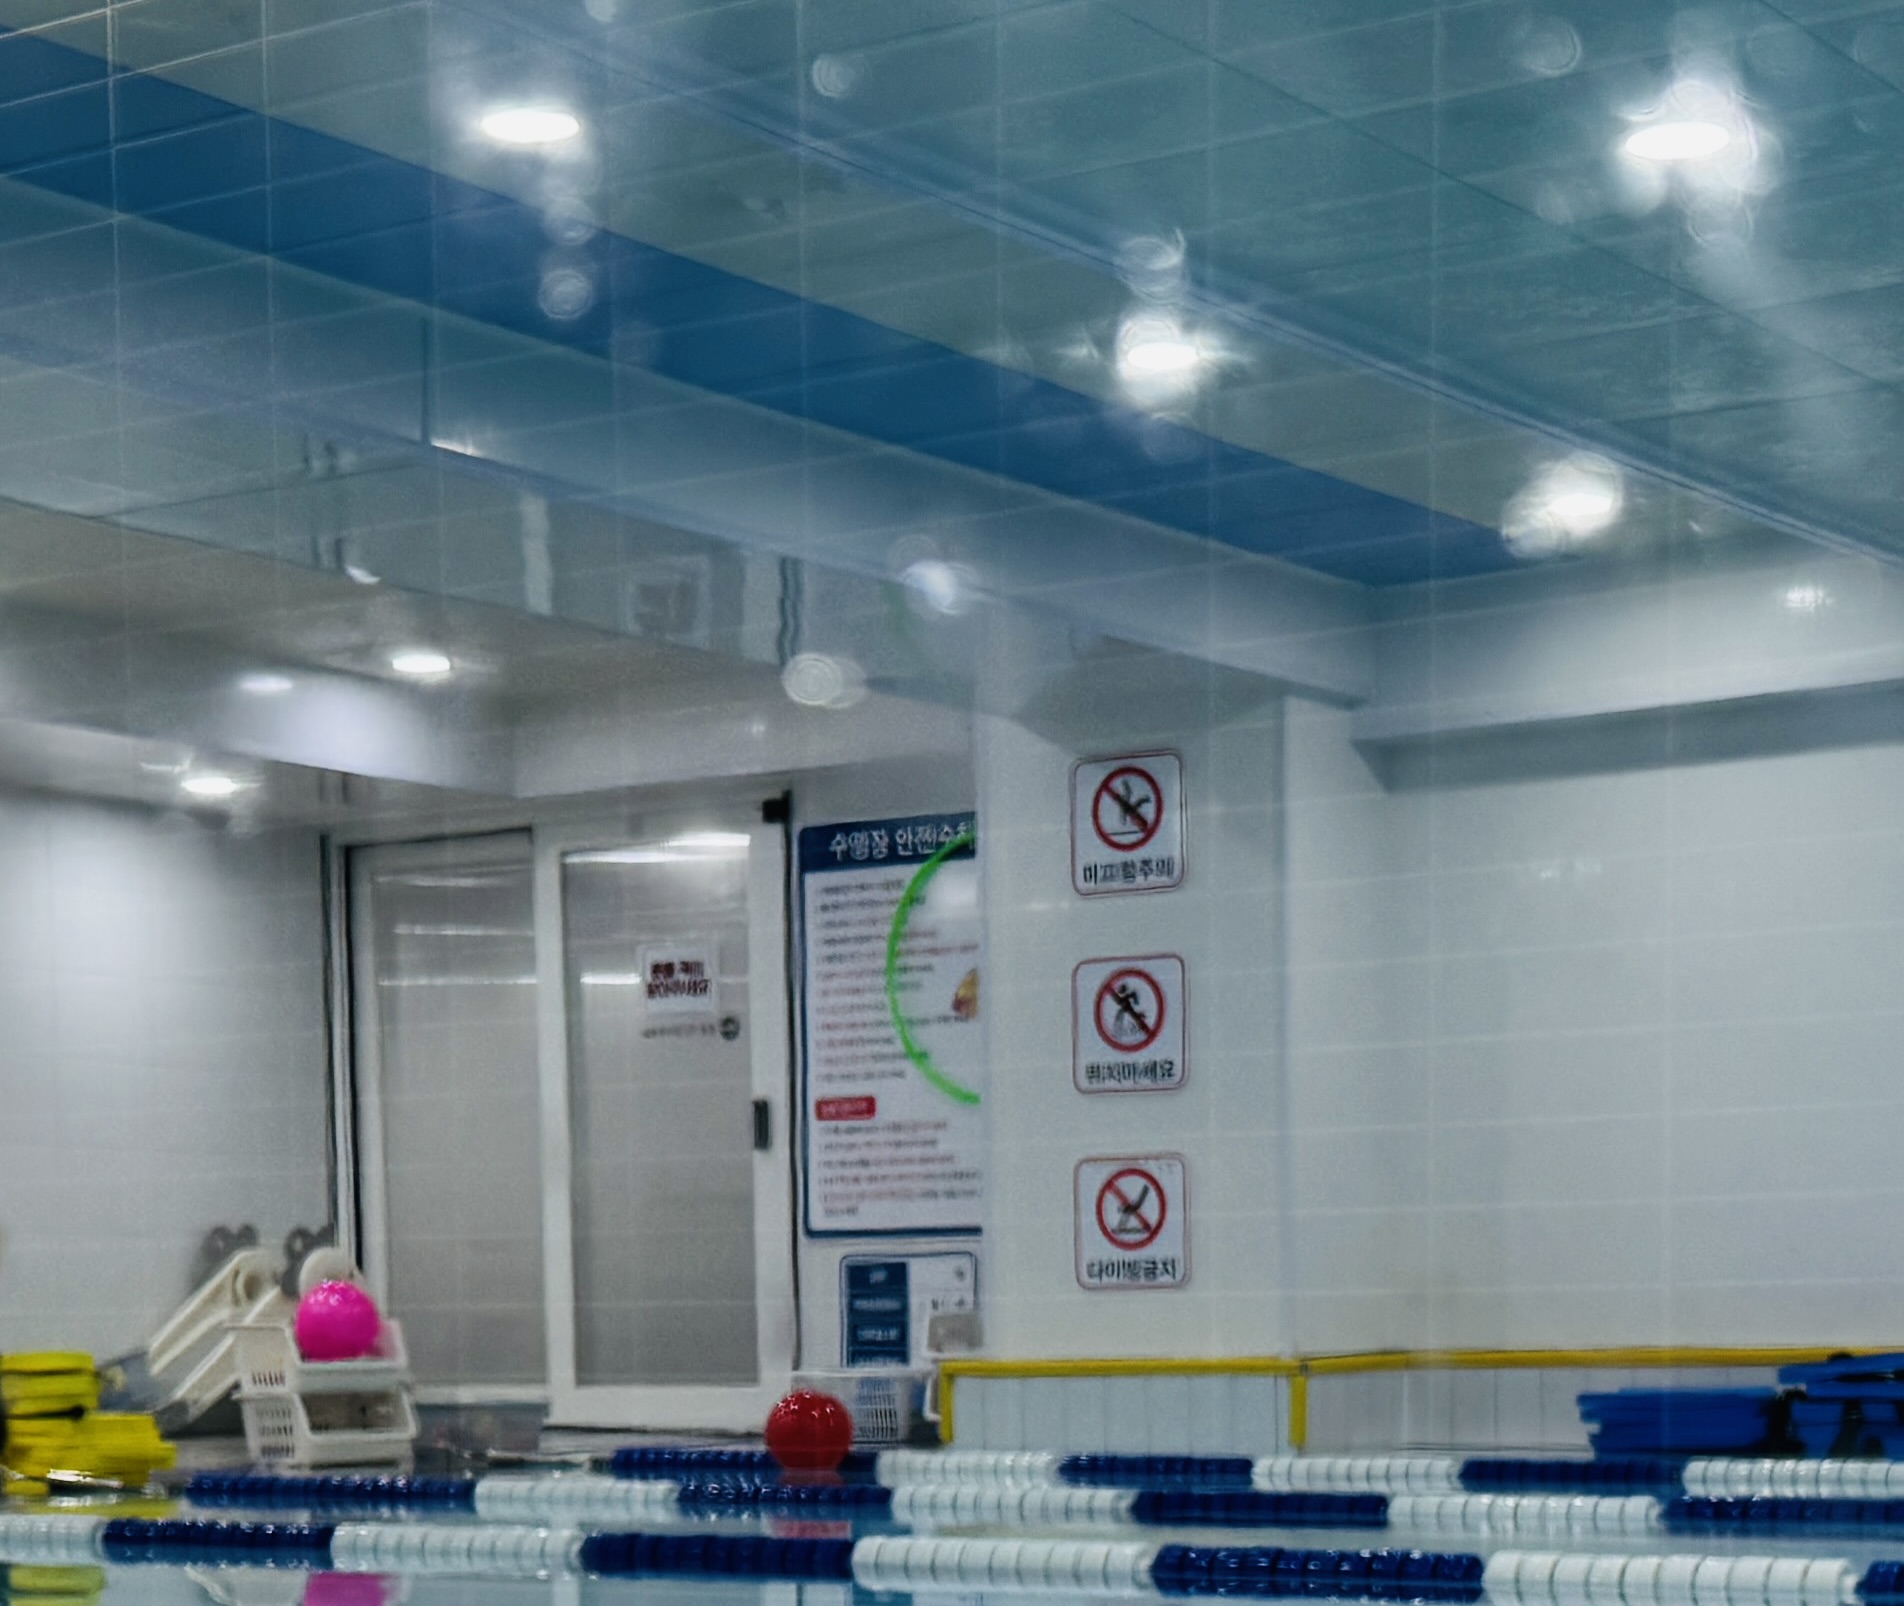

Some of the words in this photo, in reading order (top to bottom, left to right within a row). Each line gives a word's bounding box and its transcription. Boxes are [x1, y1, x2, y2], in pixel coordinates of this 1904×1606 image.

[829, 828, 890, 862] 수영장
[1083, 857, 1175, 885] 미끄럼주의
[1085, 1059, 1175, 1085] 뛰지마세요
[1086, 1258, 1177, 1284] 다이빙금지
